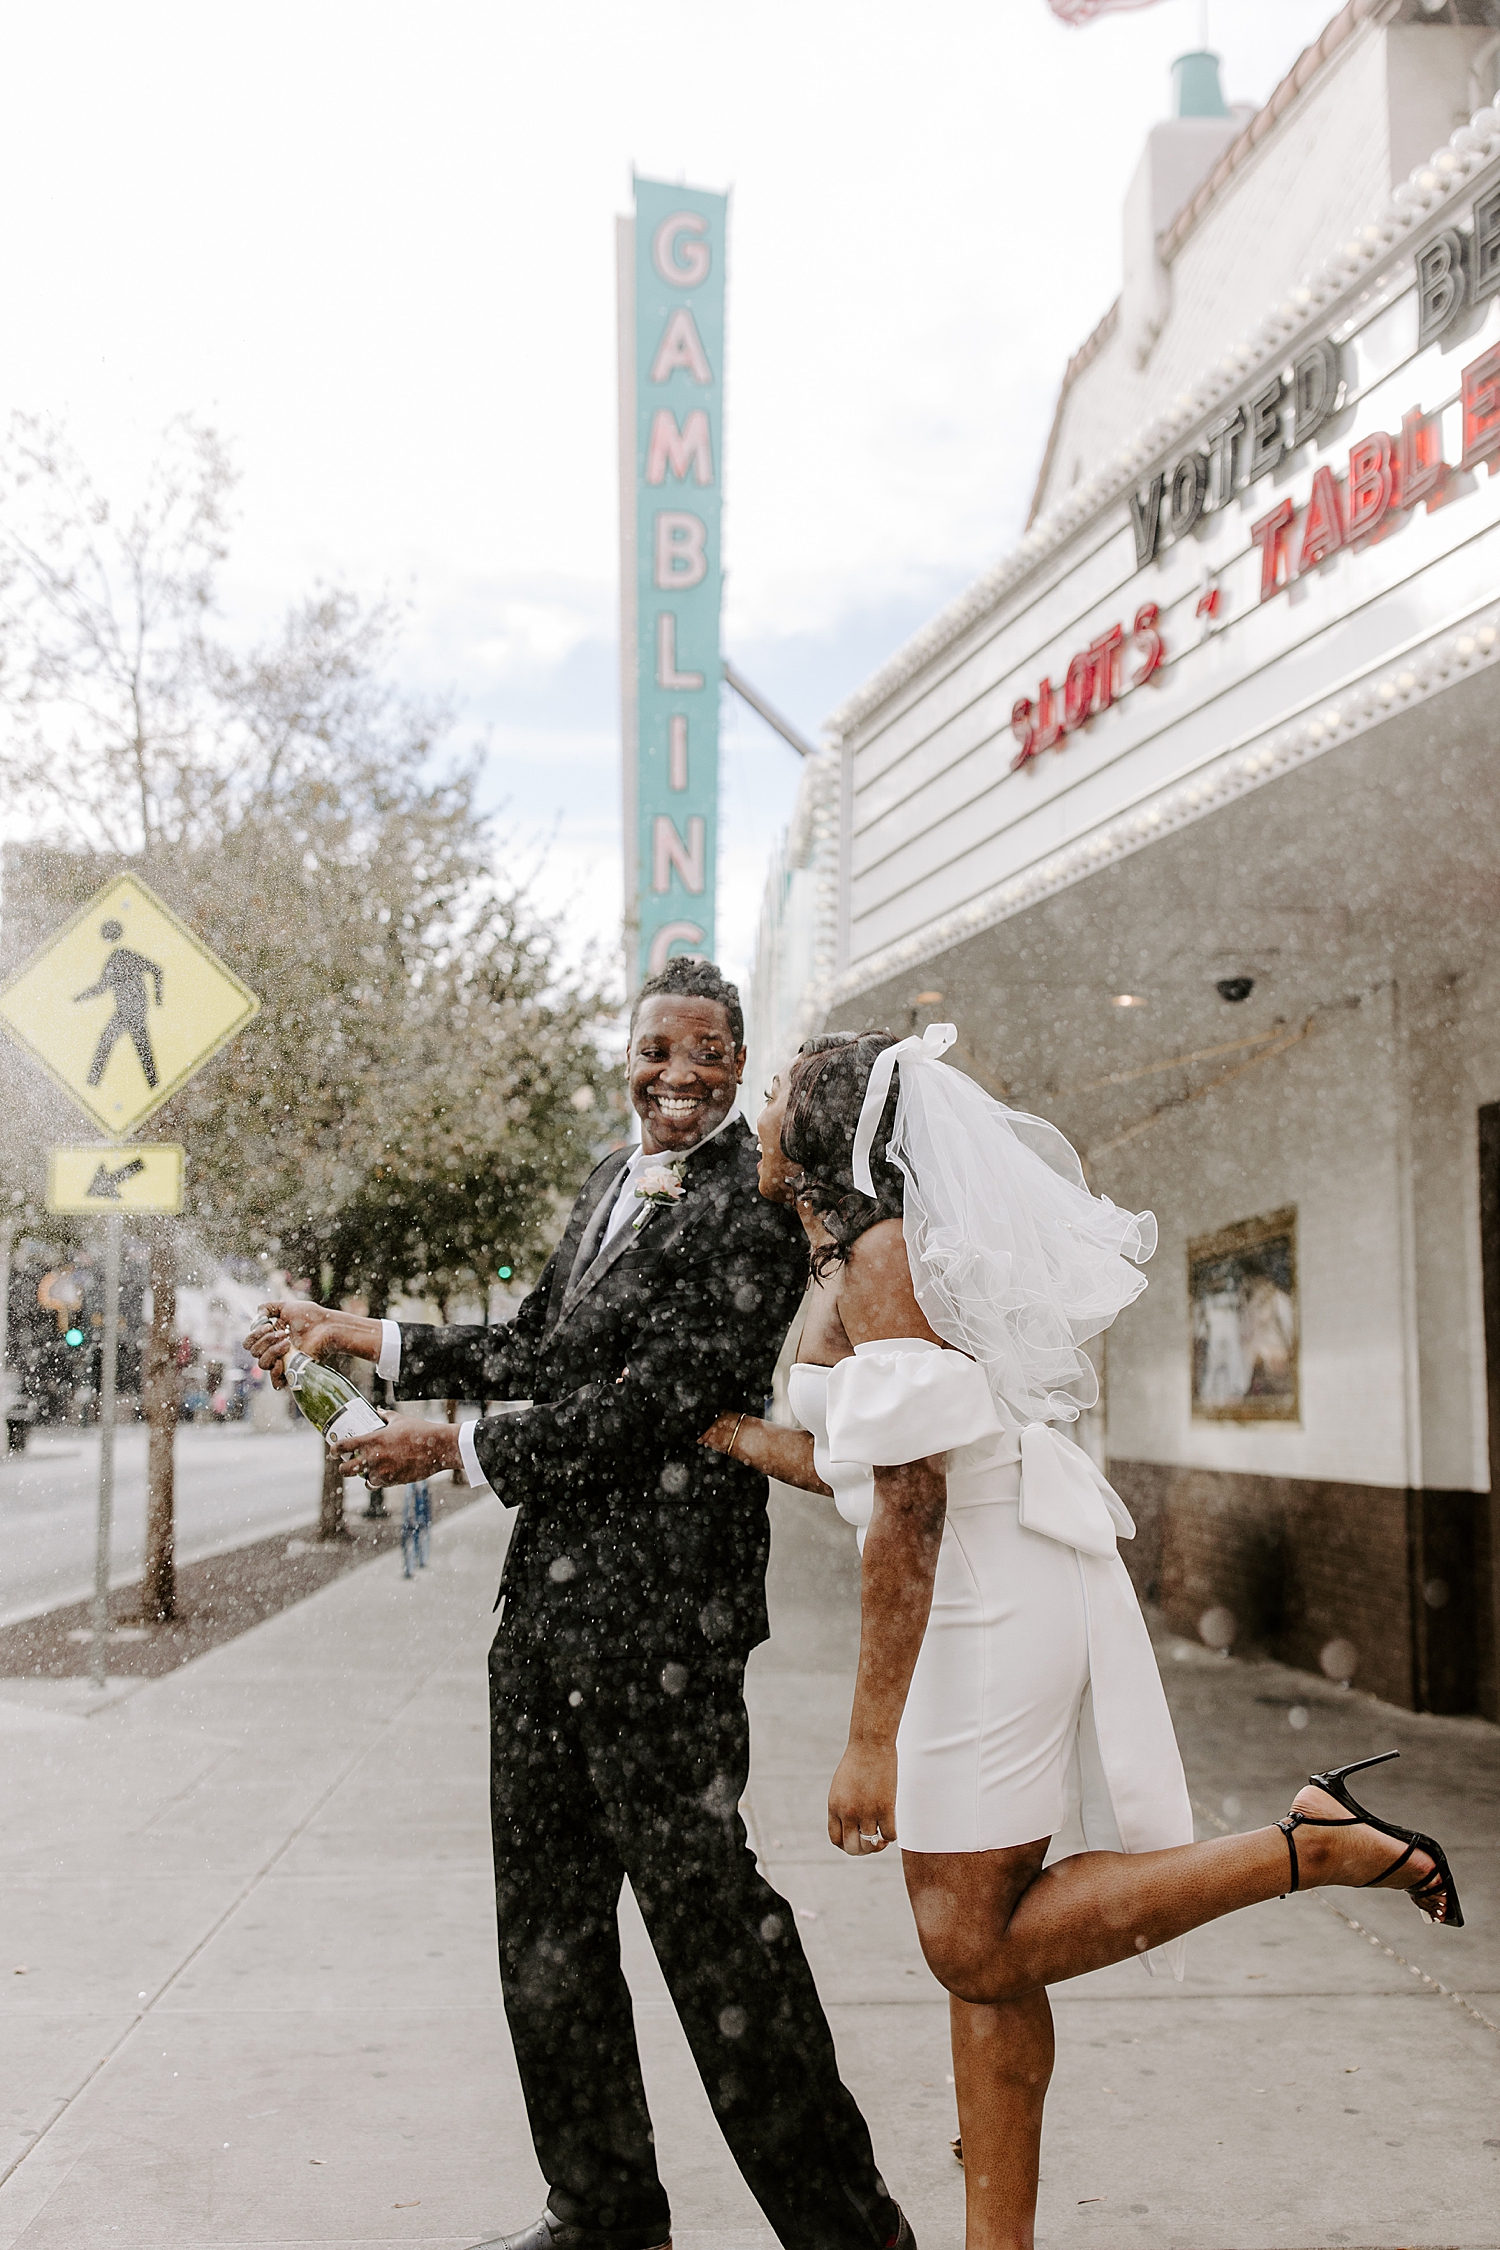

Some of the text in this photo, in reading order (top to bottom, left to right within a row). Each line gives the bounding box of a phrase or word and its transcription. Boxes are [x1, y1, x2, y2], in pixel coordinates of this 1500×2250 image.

[1010, 340, 1500, 771] SLOTS TABLE
[1129, 339, 1341, 570] VOTED
